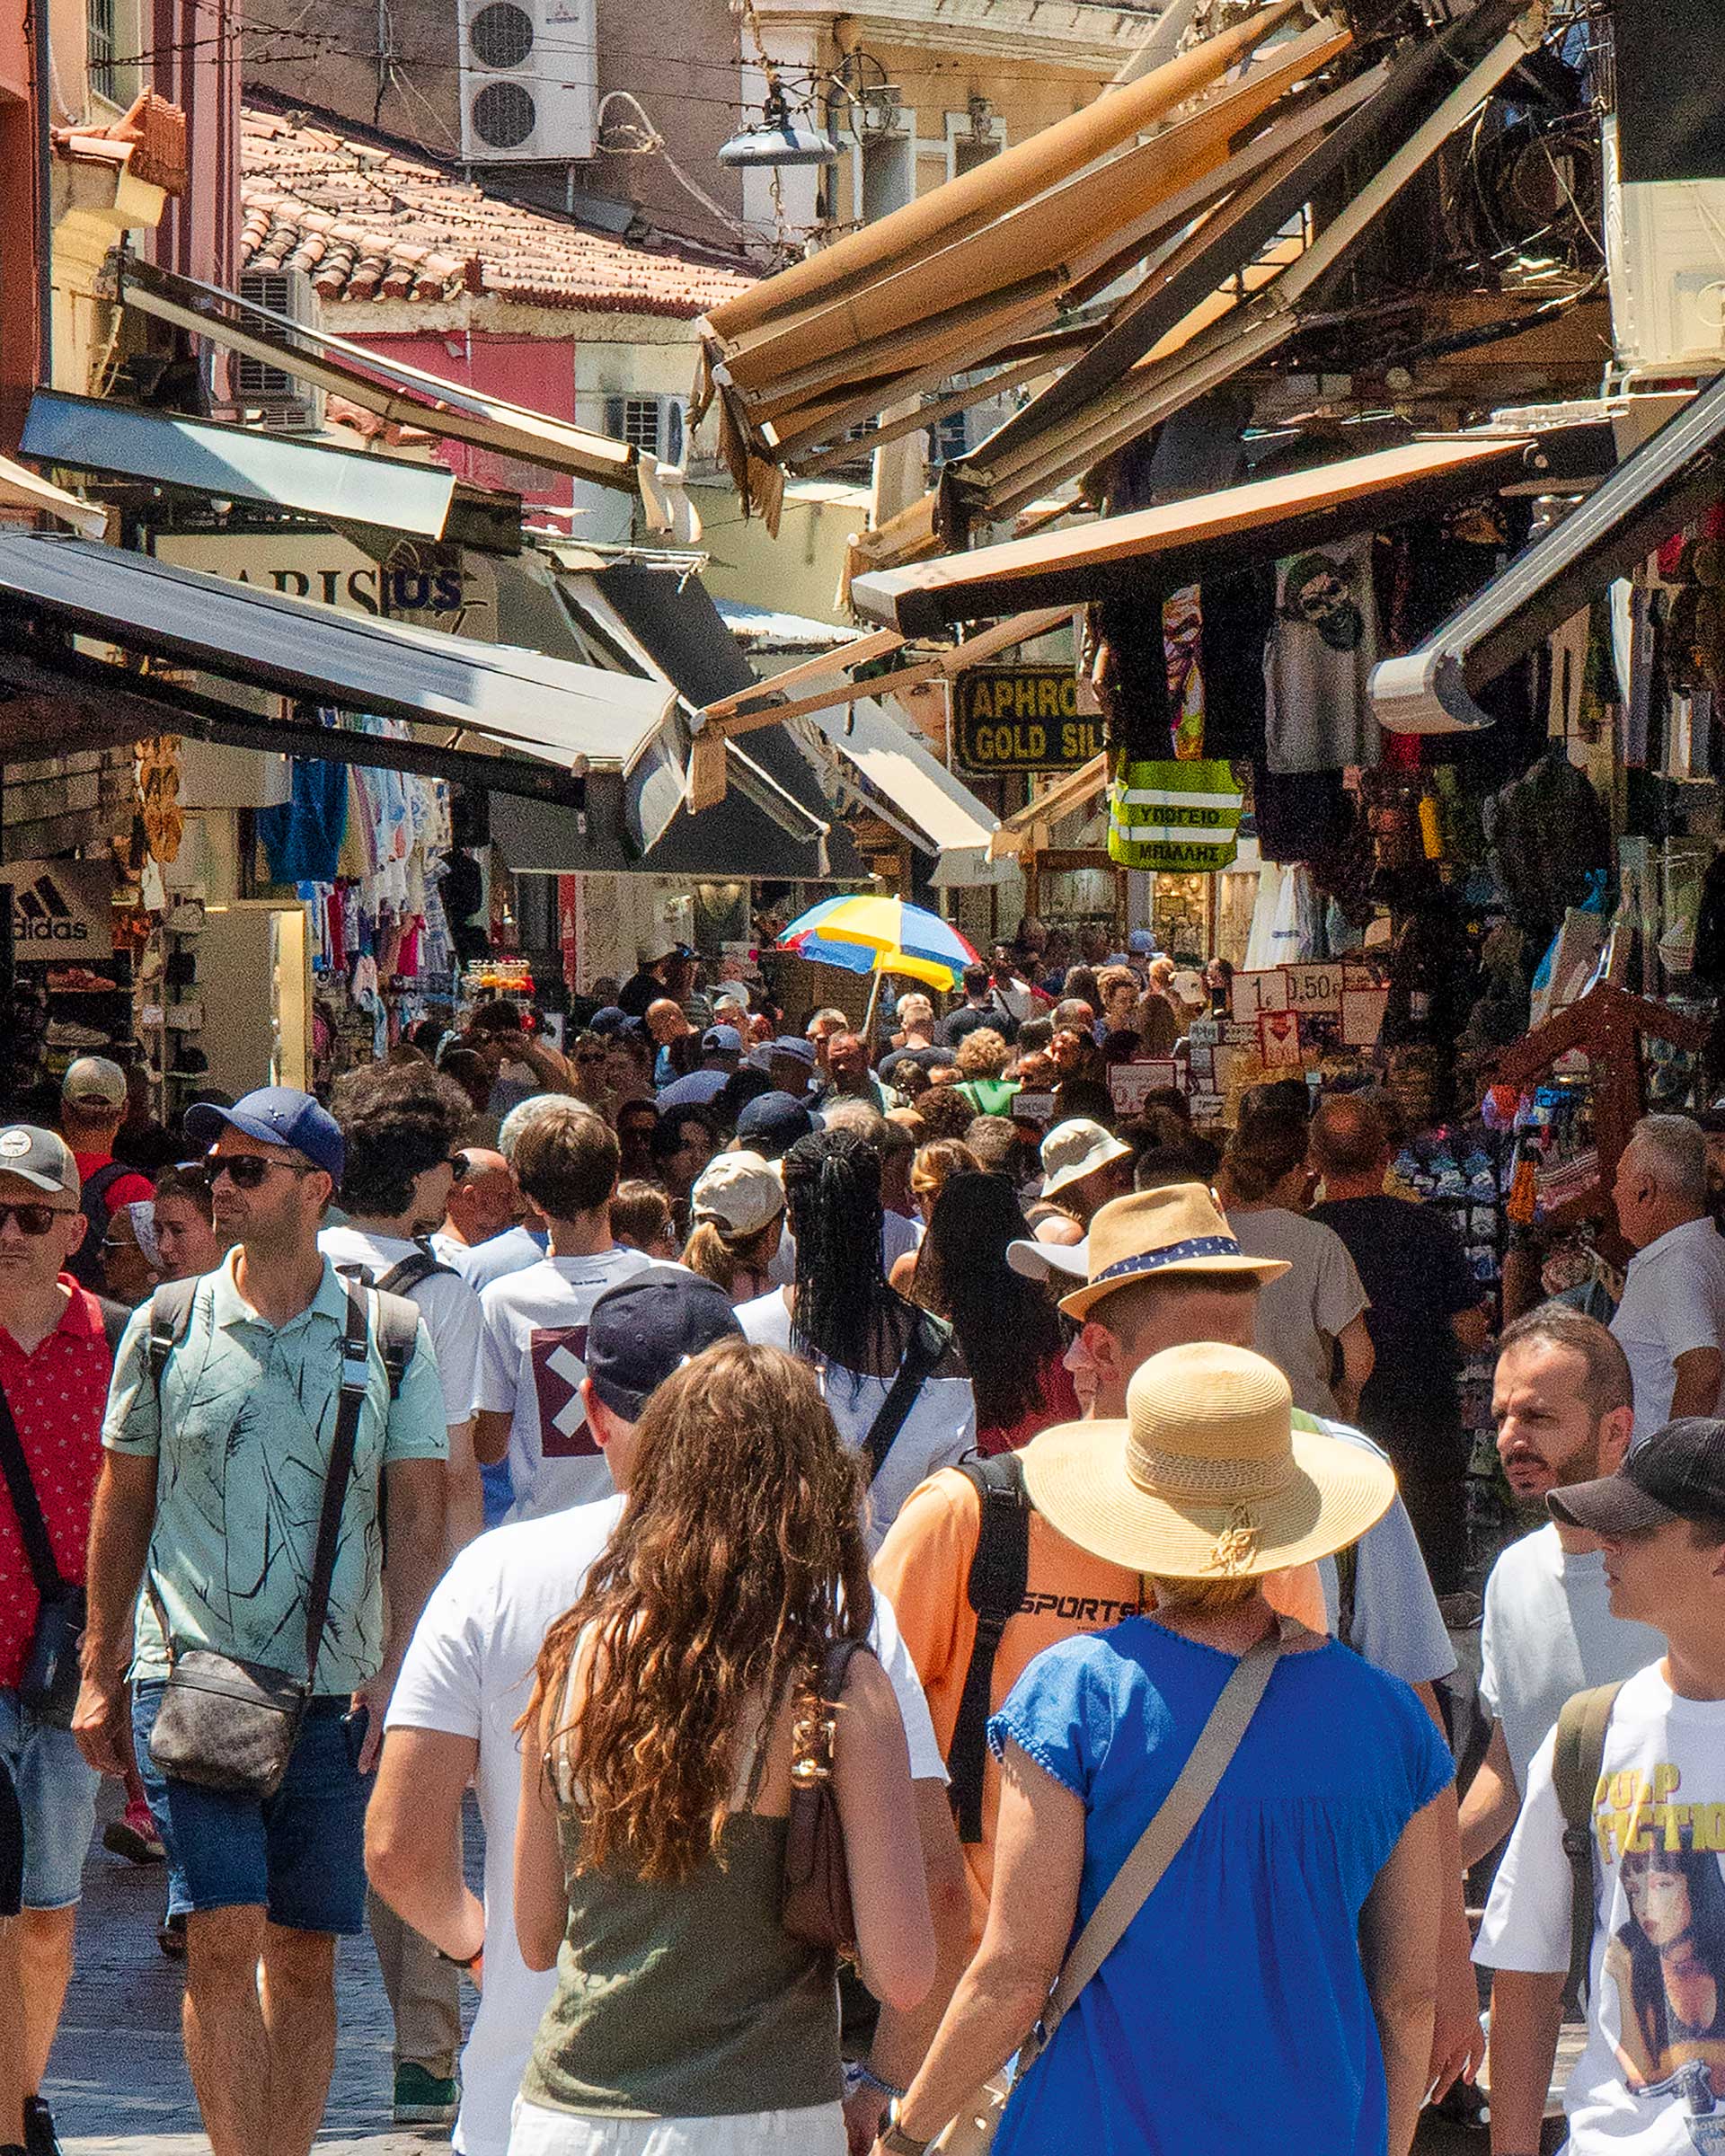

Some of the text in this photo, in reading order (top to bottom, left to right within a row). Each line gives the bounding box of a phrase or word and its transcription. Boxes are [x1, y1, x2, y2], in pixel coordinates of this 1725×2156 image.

[973, 678, 1077, 716] APHRO
[976, 724, 1046, 758] GOLD
[1594, 1763, 1681, 1816] PULP
